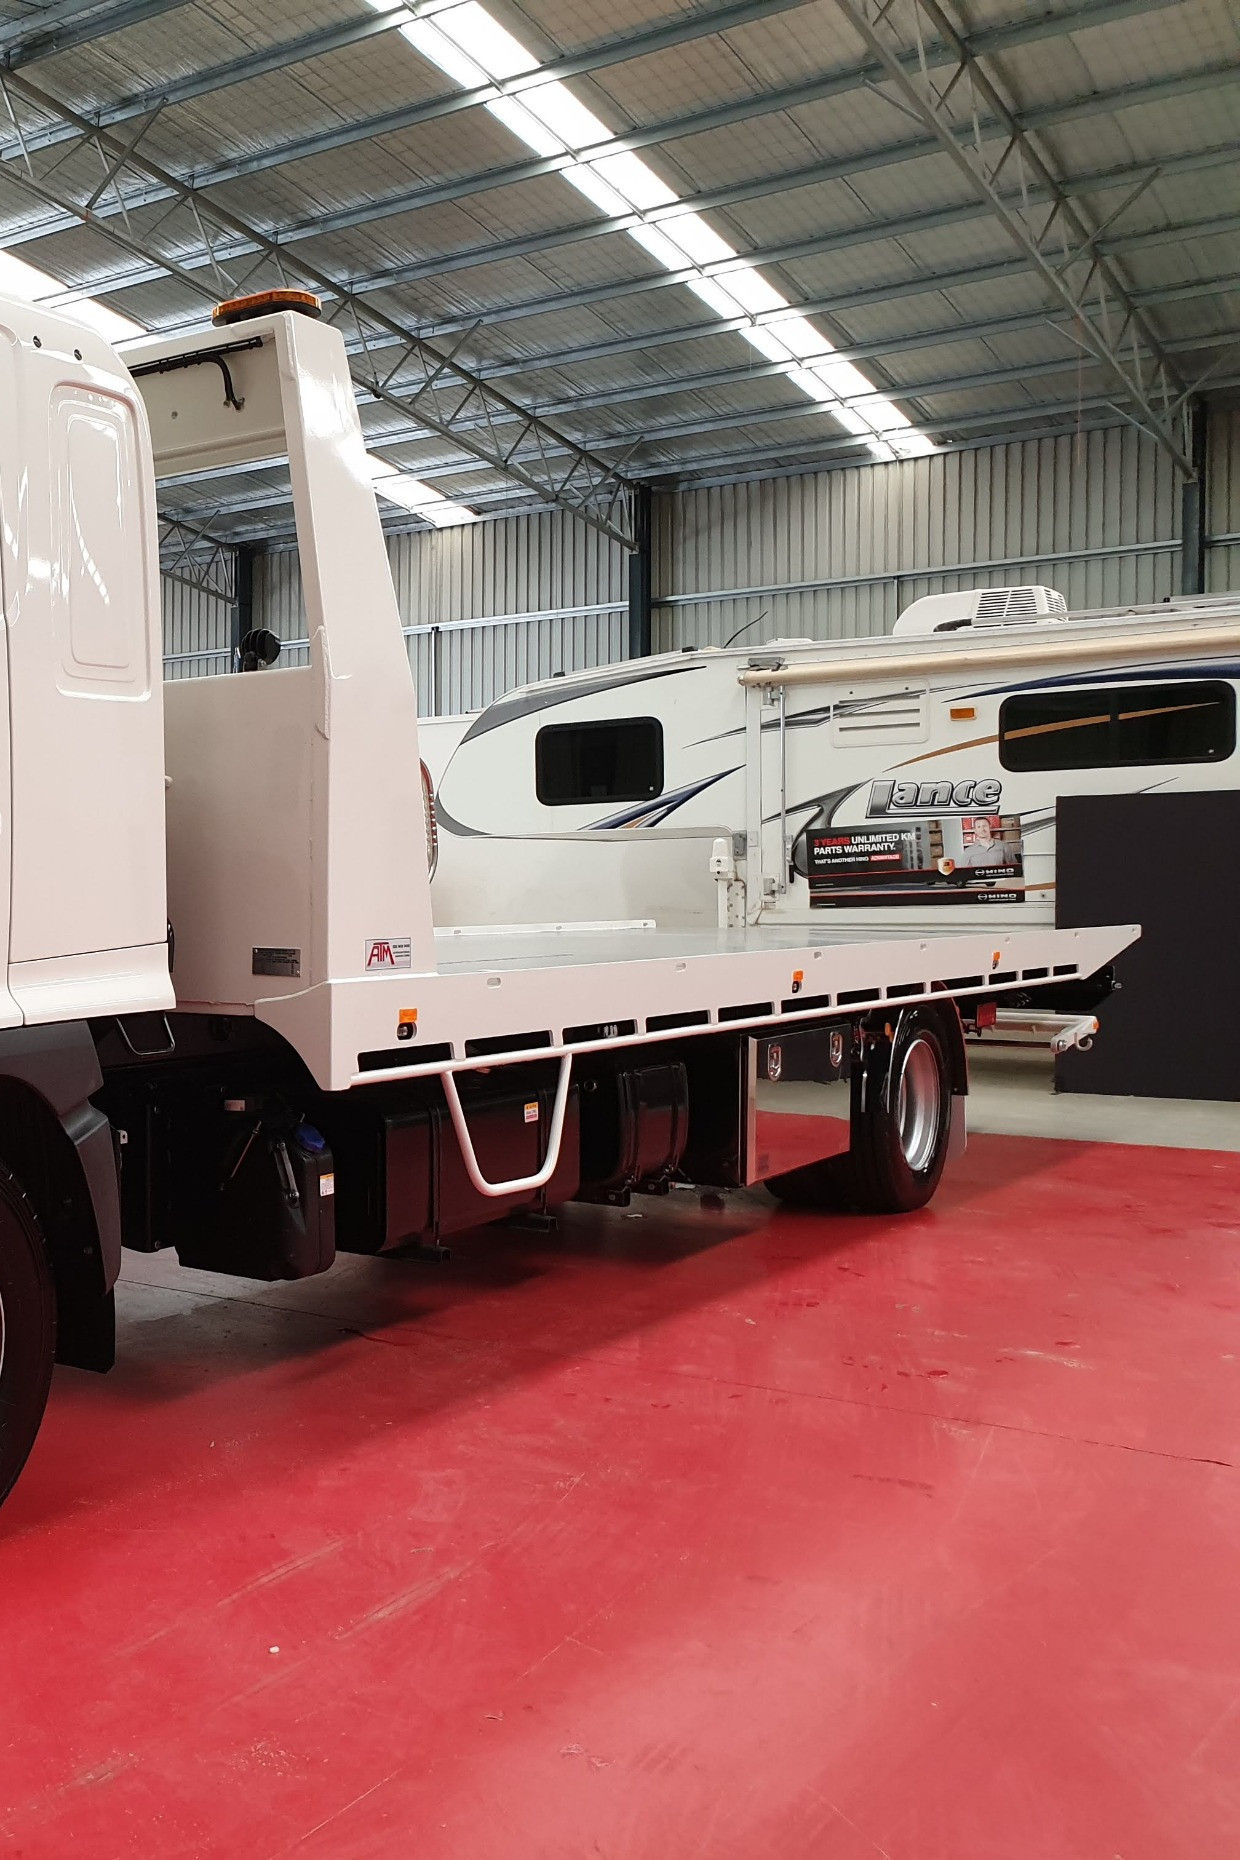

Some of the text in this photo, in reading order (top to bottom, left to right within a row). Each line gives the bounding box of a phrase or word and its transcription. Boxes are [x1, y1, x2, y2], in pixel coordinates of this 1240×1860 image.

[865, 779, 1003, 819] Lance
[813, 842, 896, 856] PARTS WARRANTY.
[821, 837, 851, 846] YEARS
[851, 833, 900, 844] UNLIMITED
[900, 832, 916, 841] KM
[366, 941, 395, 967] ATM
